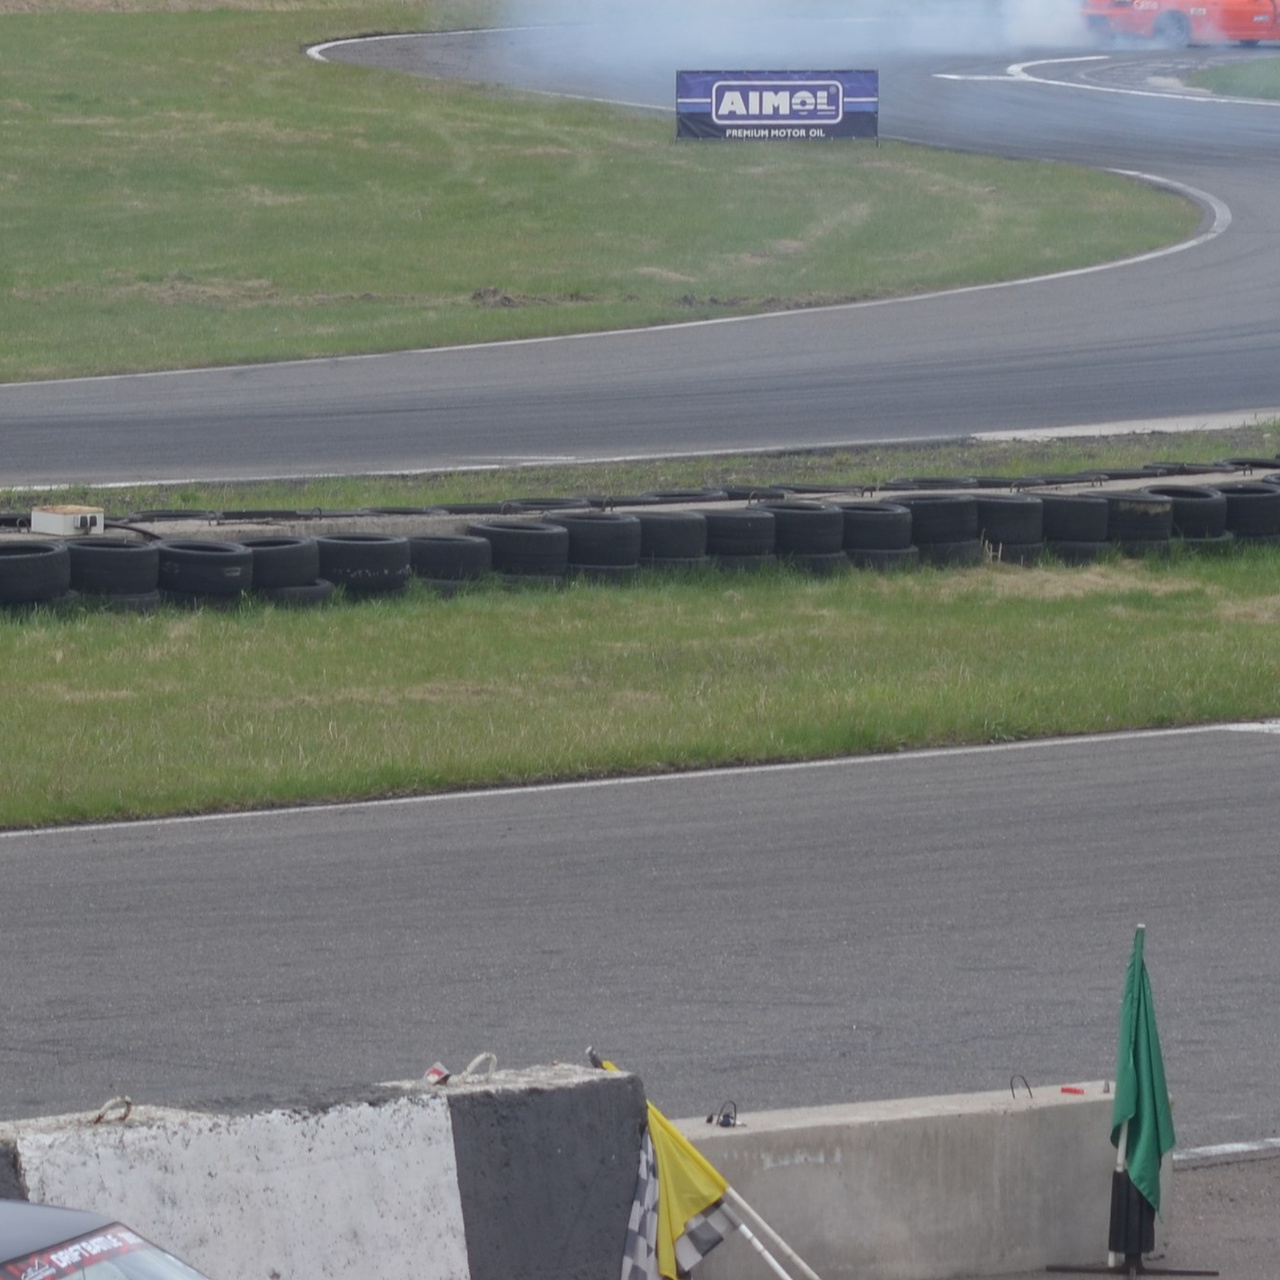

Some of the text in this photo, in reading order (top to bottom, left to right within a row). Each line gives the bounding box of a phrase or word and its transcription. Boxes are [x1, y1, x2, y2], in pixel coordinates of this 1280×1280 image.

[718, 91, 836, 115] AIMOL
[726, 128, 825, 138] PREMIUM MOTOR OIL
[50, 1243, 90, 1268] DRIFT
